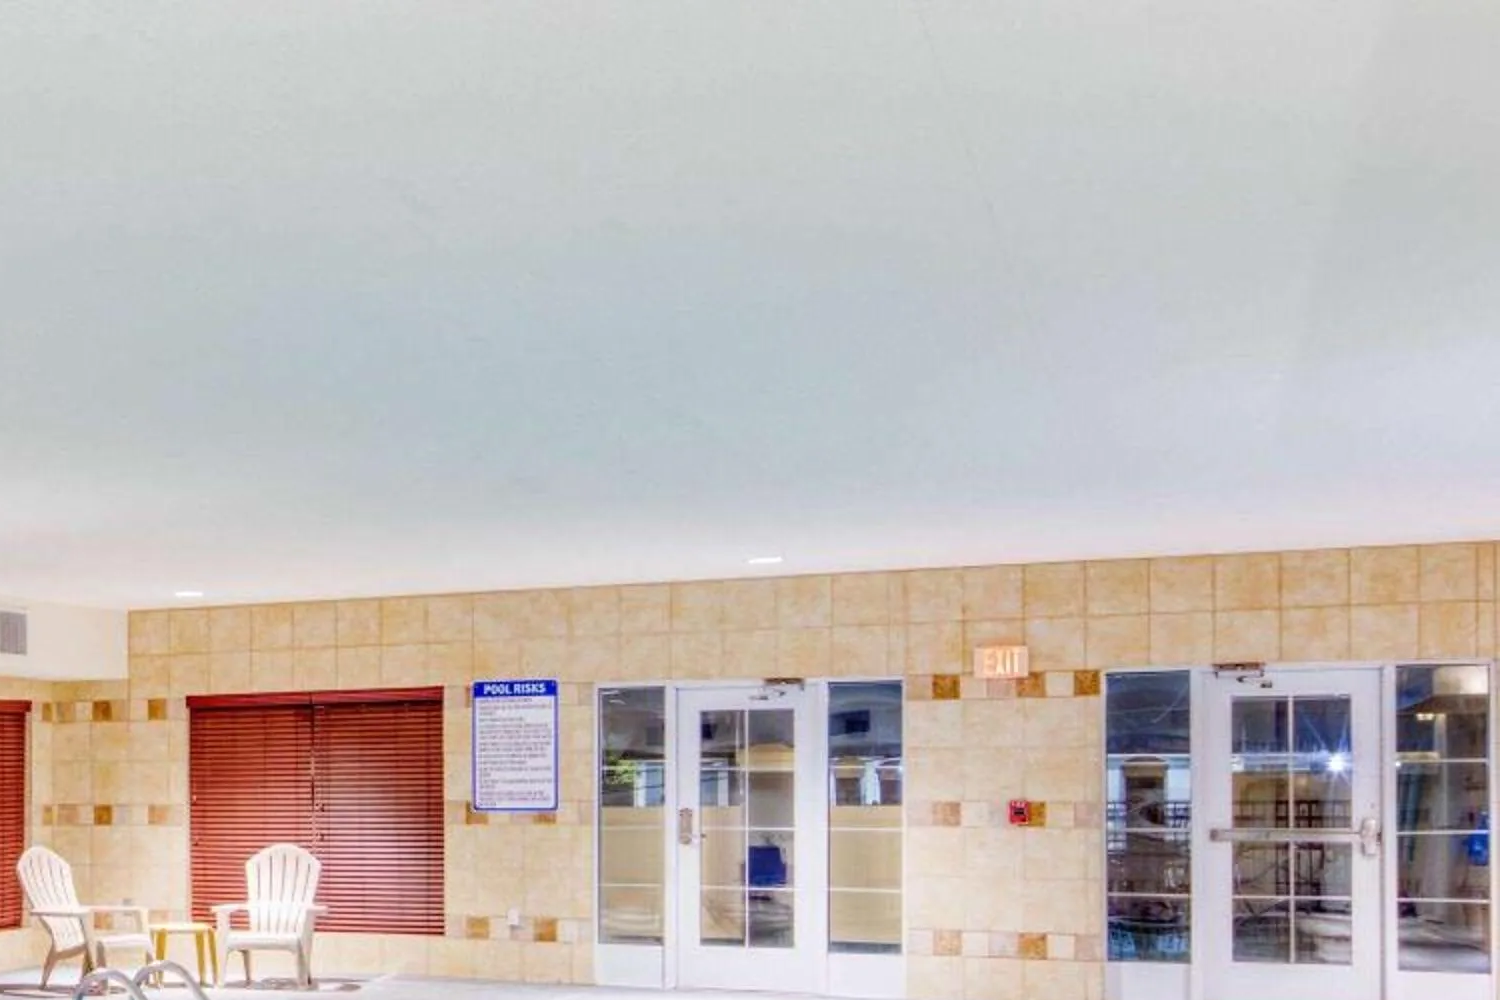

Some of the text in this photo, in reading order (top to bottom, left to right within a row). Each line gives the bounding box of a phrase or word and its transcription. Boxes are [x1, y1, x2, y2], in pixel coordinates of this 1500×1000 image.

[984, 650, 1019, 675] EXIT
[483, 683, 547, 695] POOL RISKS
